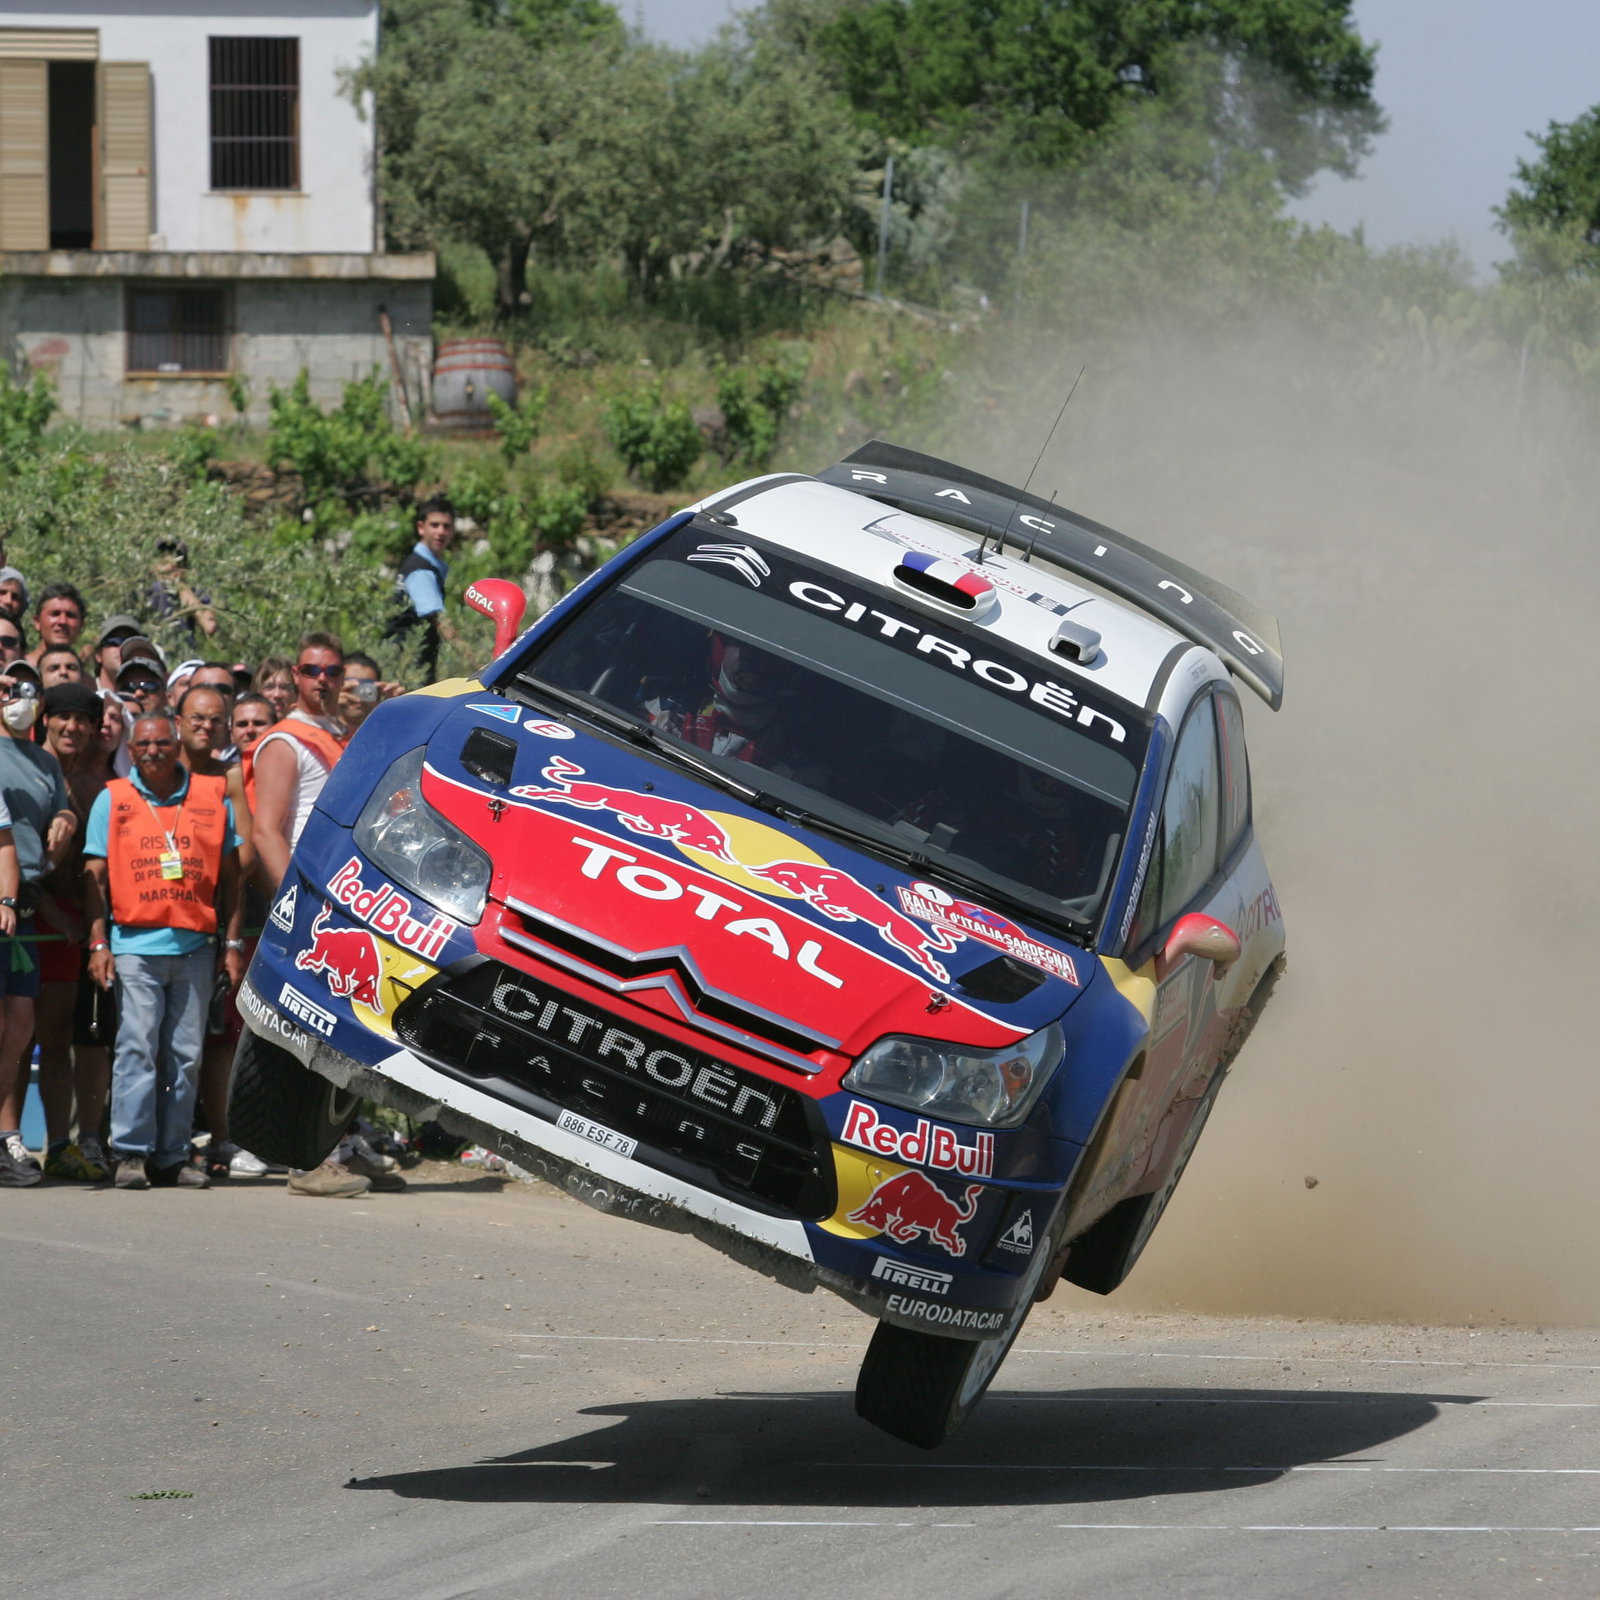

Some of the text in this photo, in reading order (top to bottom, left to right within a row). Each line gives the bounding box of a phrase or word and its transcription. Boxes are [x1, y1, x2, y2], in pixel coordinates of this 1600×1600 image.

[852, 470, 1264, 655] RACING
[465, 585, 495, 612] TOTAL
[788, 581, 1126, 743] CITROËN
[326, 856, 457, 961] Red Bull
[572, 836, 844, 989] TOTAL
[902, 890, 946, 919] RALLY
[240, 980, 308, 1050] EURODATACAR
[279, 982, 338, 1037] PIRELLI
[492, 983, 777, 1128] CITROËN
[563, 1116, 630, 1153] 886 ESF 78
[840, 1100, 995, 1179] Red Bull
[871, 1256, 953, 1294] PIRELLI
[886, 1294, 1004, 1329] EURODATACAR
